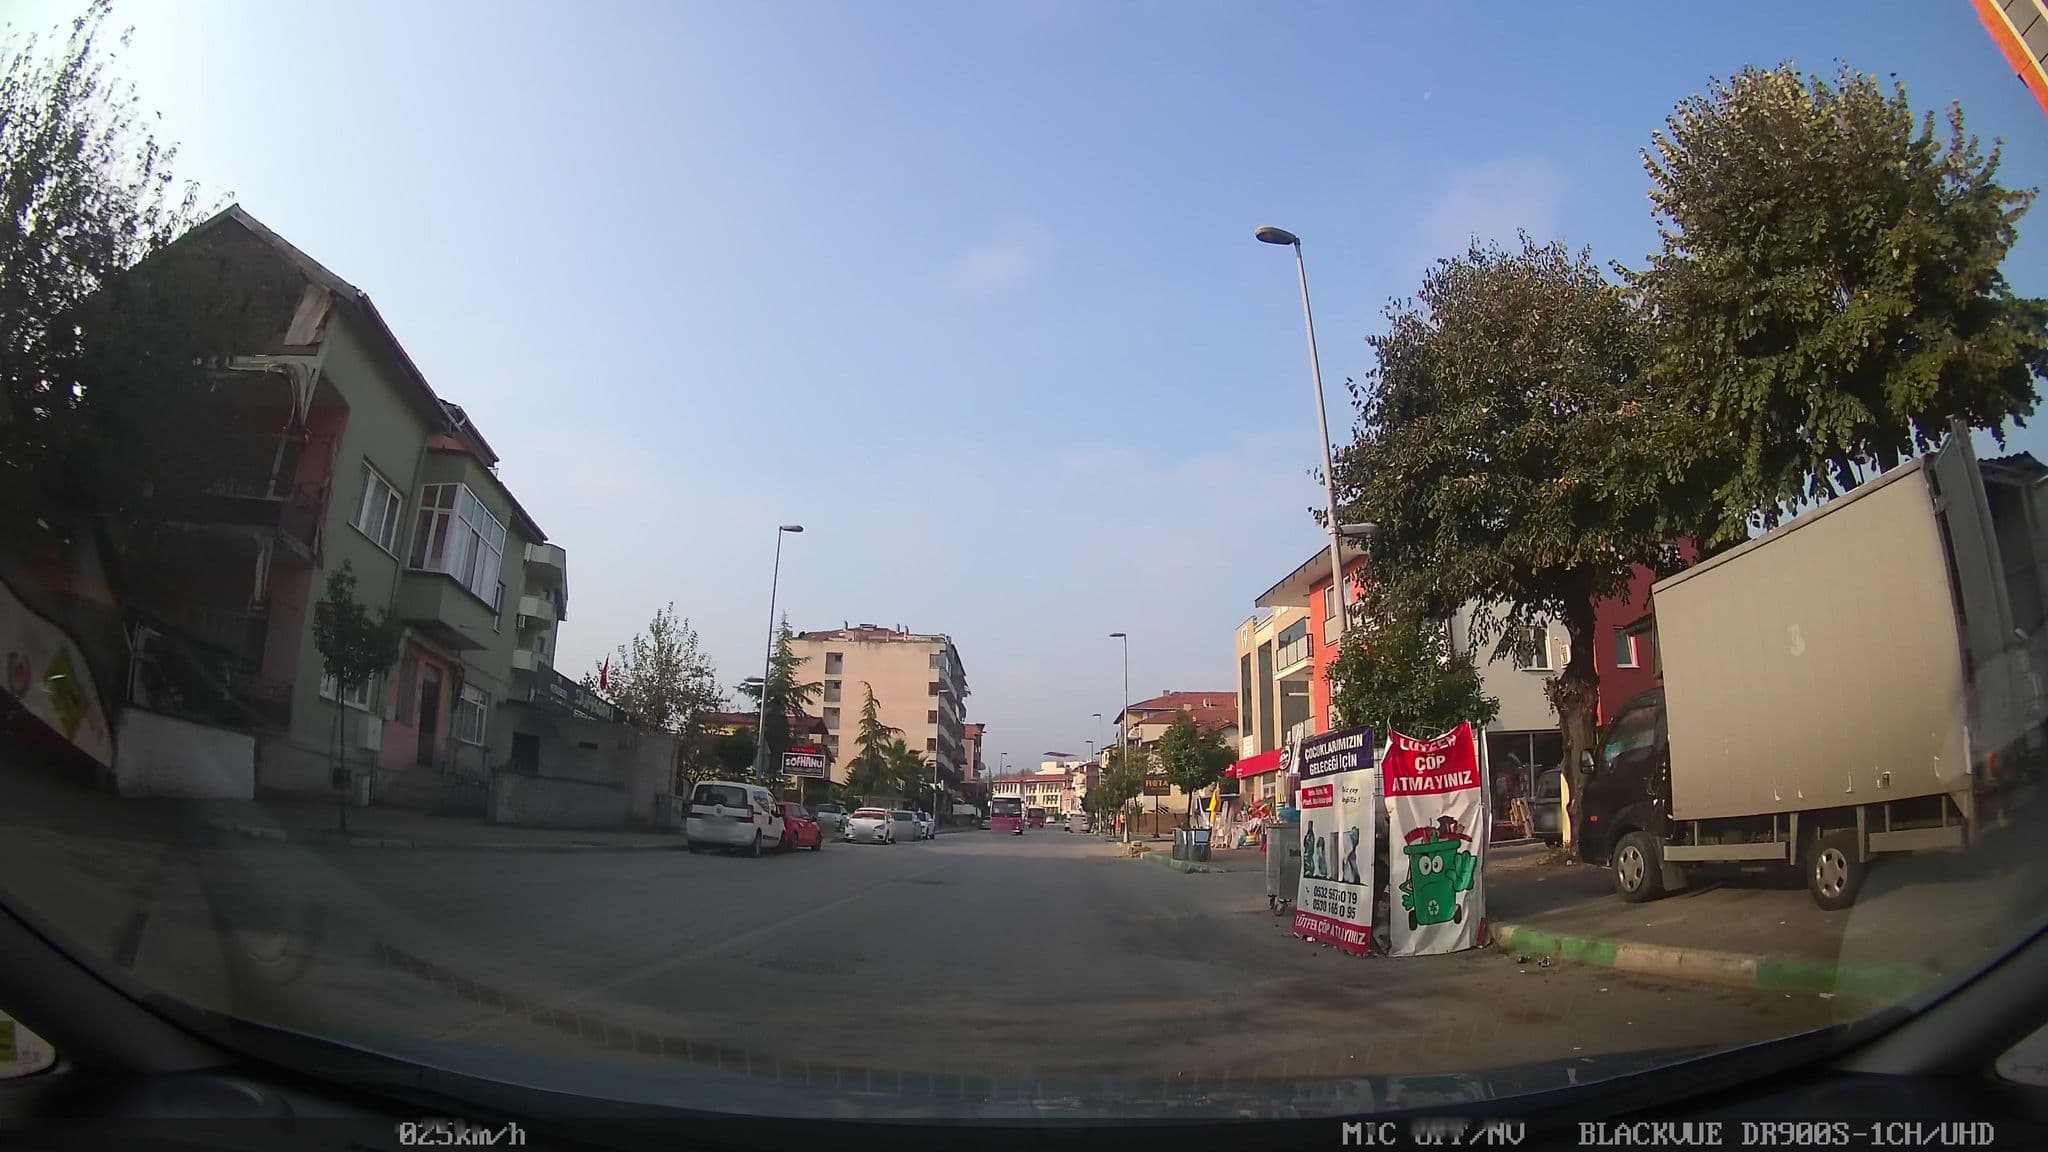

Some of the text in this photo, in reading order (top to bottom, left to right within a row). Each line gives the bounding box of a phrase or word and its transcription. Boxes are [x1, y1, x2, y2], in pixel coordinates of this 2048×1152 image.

[1415, 753, 1446, 774] ÇÖP
[1392, 770, 1472, 792] ATMAYINIZ
[1347, 891, 1357, 904] 79
[1346, 906, 1356, 920] 95
